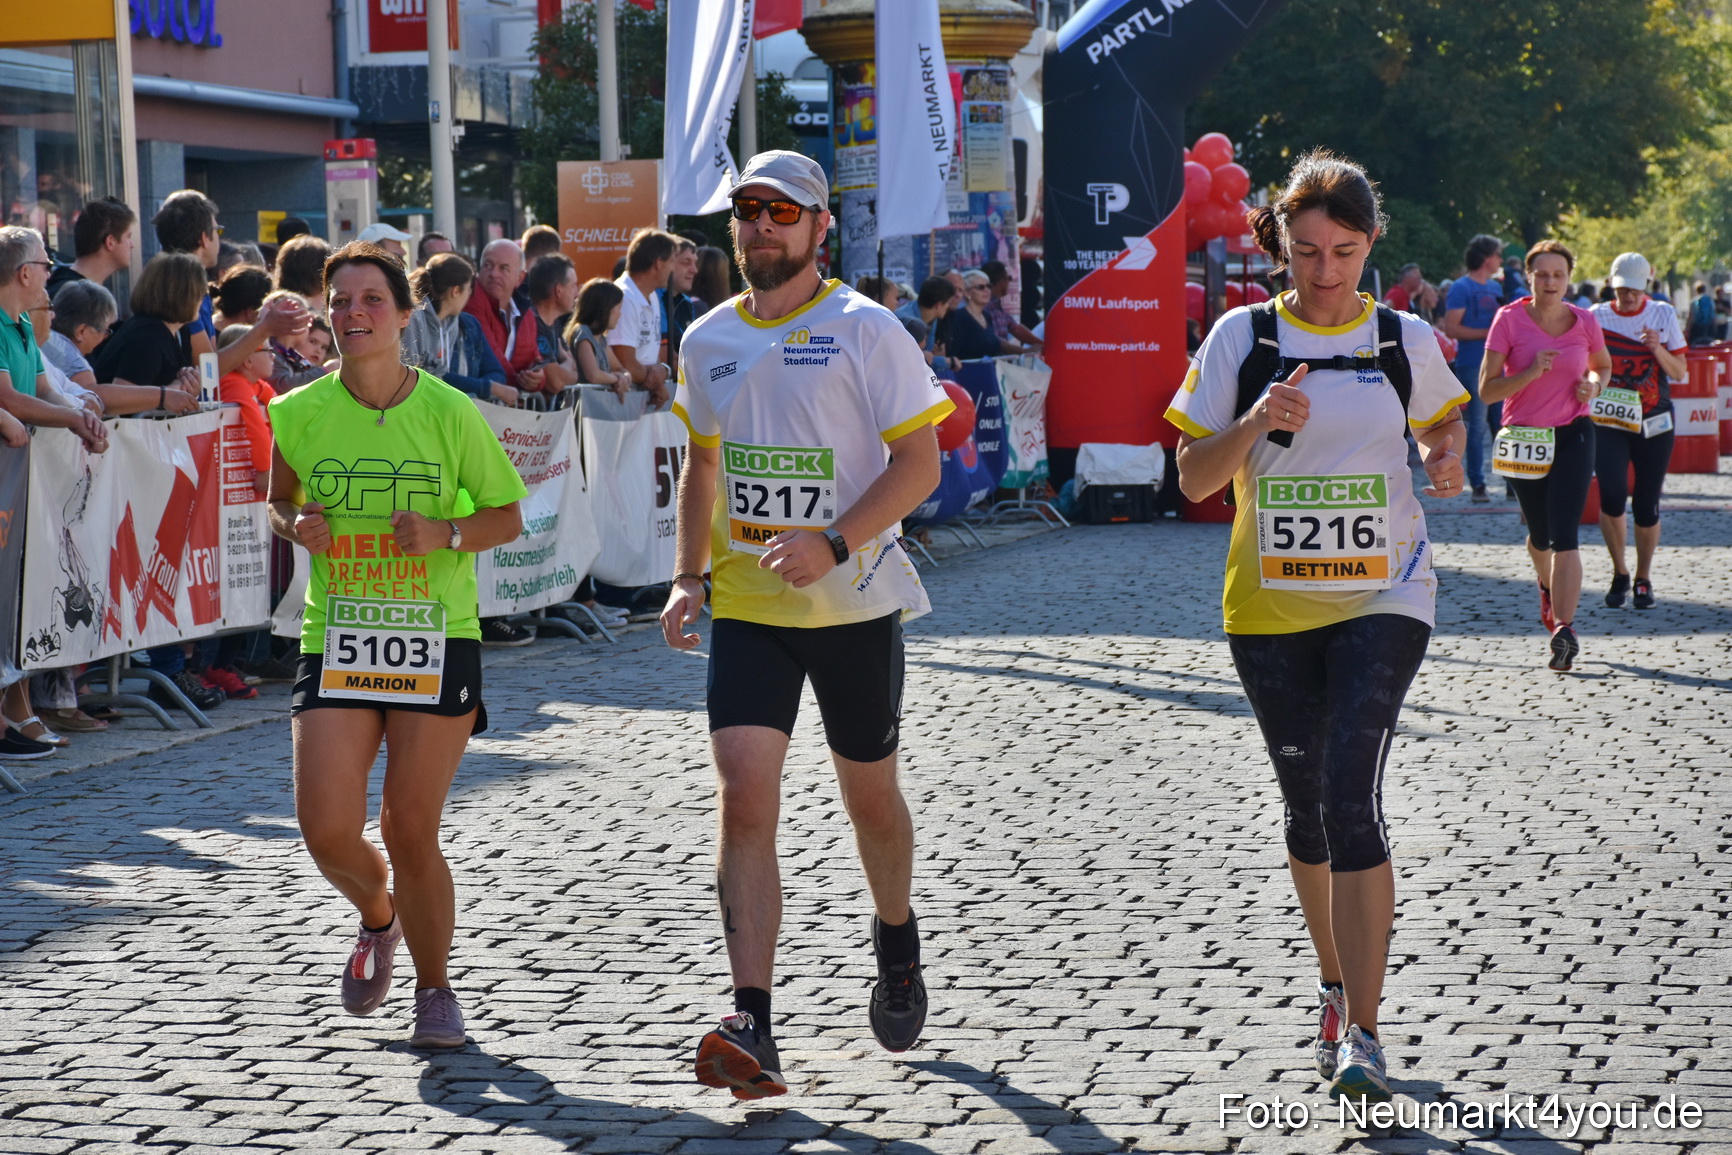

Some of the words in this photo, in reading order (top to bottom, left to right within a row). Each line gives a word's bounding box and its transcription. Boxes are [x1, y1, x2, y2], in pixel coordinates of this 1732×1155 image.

[1086, 7, 1164, 64] PARTL
[918, 43, 949, 153] NEUMARKT
[1076, 251, 1093, 260] THE
[1095, 251, 1119, 260] NEXT
[1063, 261, 1077, 270] 100
[1078, 260, 1109, 270] YEARS
[1064, 297, 1095, 309] BMW
[1098, 296, 1159, 311] Laufsport
[784, 329, 809, 344] 20
[783, 346, 841, 354] Neumarkter
[1065, 341, 1160, 352] www.bmw-partl.de
[711, 362, 737, 378] BOCK
[783, 357, 830, 366] Stadtlauf
[1594, 402, 1636, 421] 5084
[1597, 418, 1631, 429] ANDREA
[1499, 441, 1547, 462] 5119
[729, 446, 825, 476] BOCK
[1497, 461, 1546, 473] CHRISTIANE
[735, 481, 820, 519] 5217
[1267, 479, 1378, 505] BOCK
[1273, 515, 1375, 550] 5216
[326, 533, 427, 559] MER
[327, 560, 427, 581] PREMIUM
[1282, 562, 1368, 577] BETTINA
[327, 581, 429, 599] REISEN
[334, 600, 435, 628] BOCK
[337, 634, 430, 668] 5103
[345, 676, 417, 691] MARION
